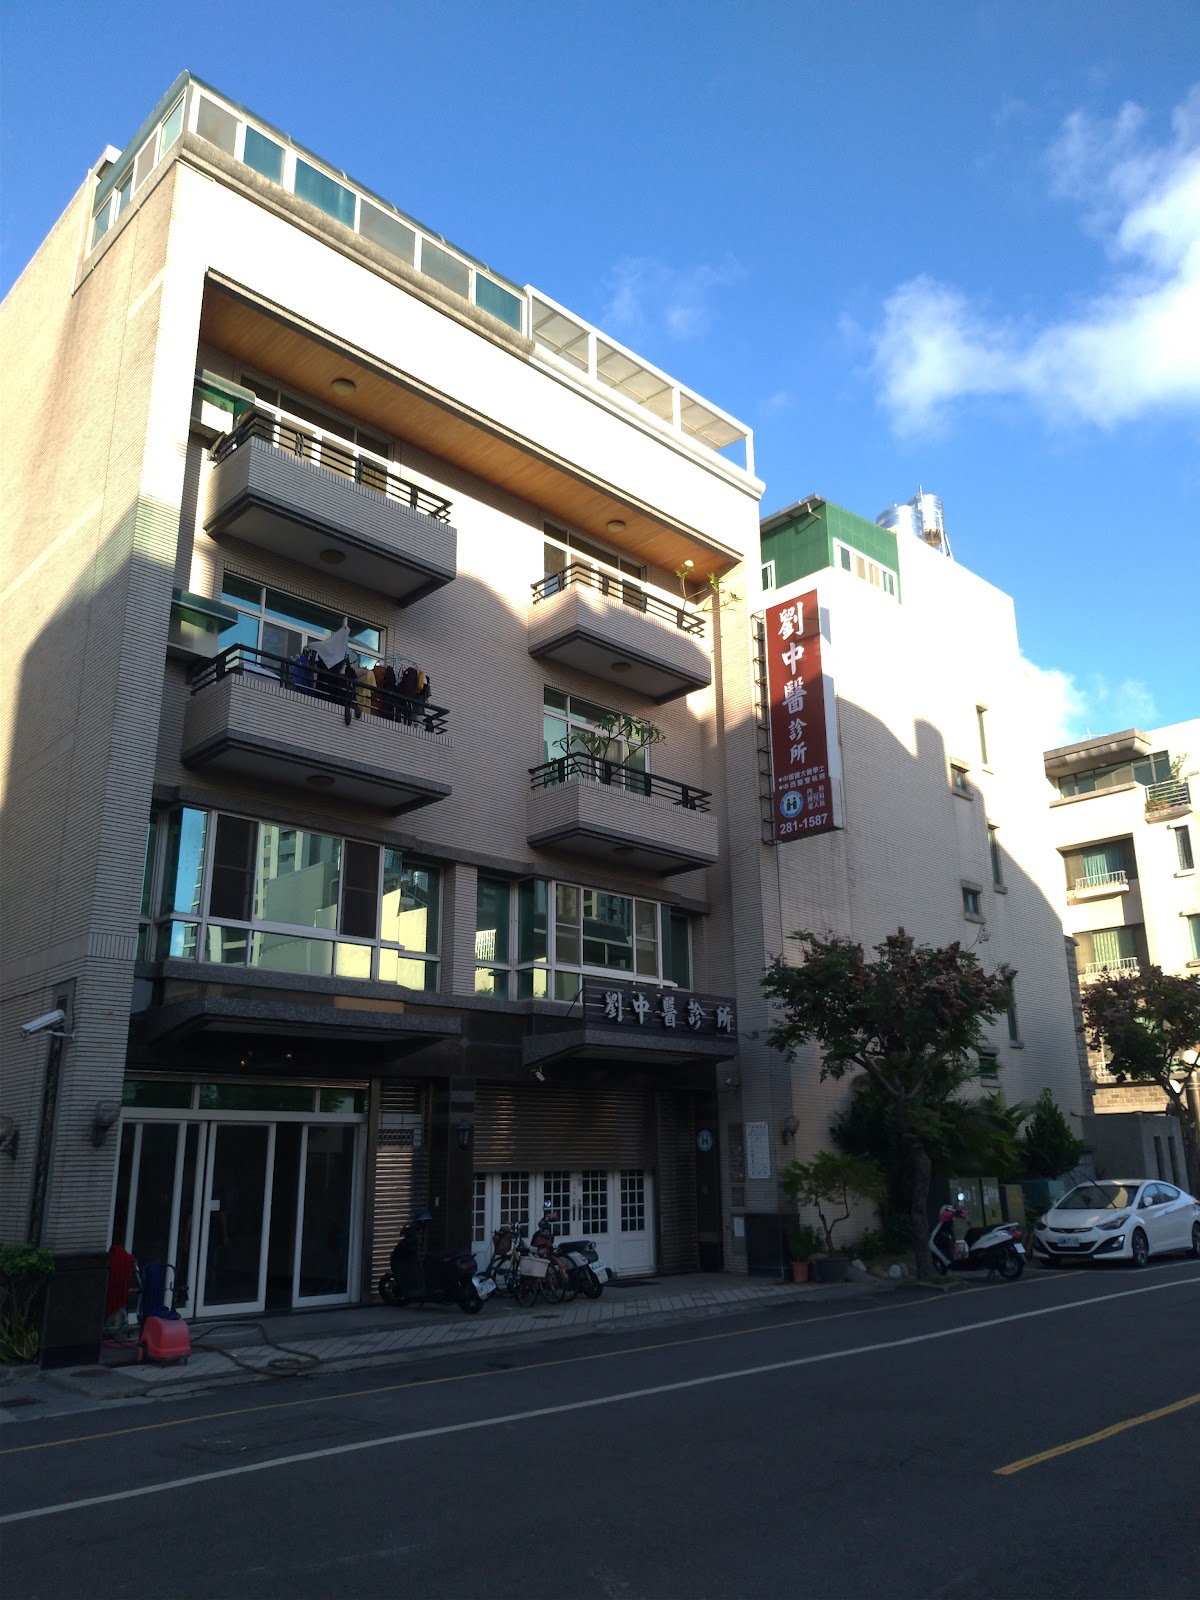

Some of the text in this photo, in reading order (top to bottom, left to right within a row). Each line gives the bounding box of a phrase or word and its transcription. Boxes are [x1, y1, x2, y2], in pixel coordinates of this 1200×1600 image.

[778, 601, 807, 764] 劉中醫診所
[780, 813, 828, 834] 281-1587
[604, 991, 734, 1033] 劉中醫診所
